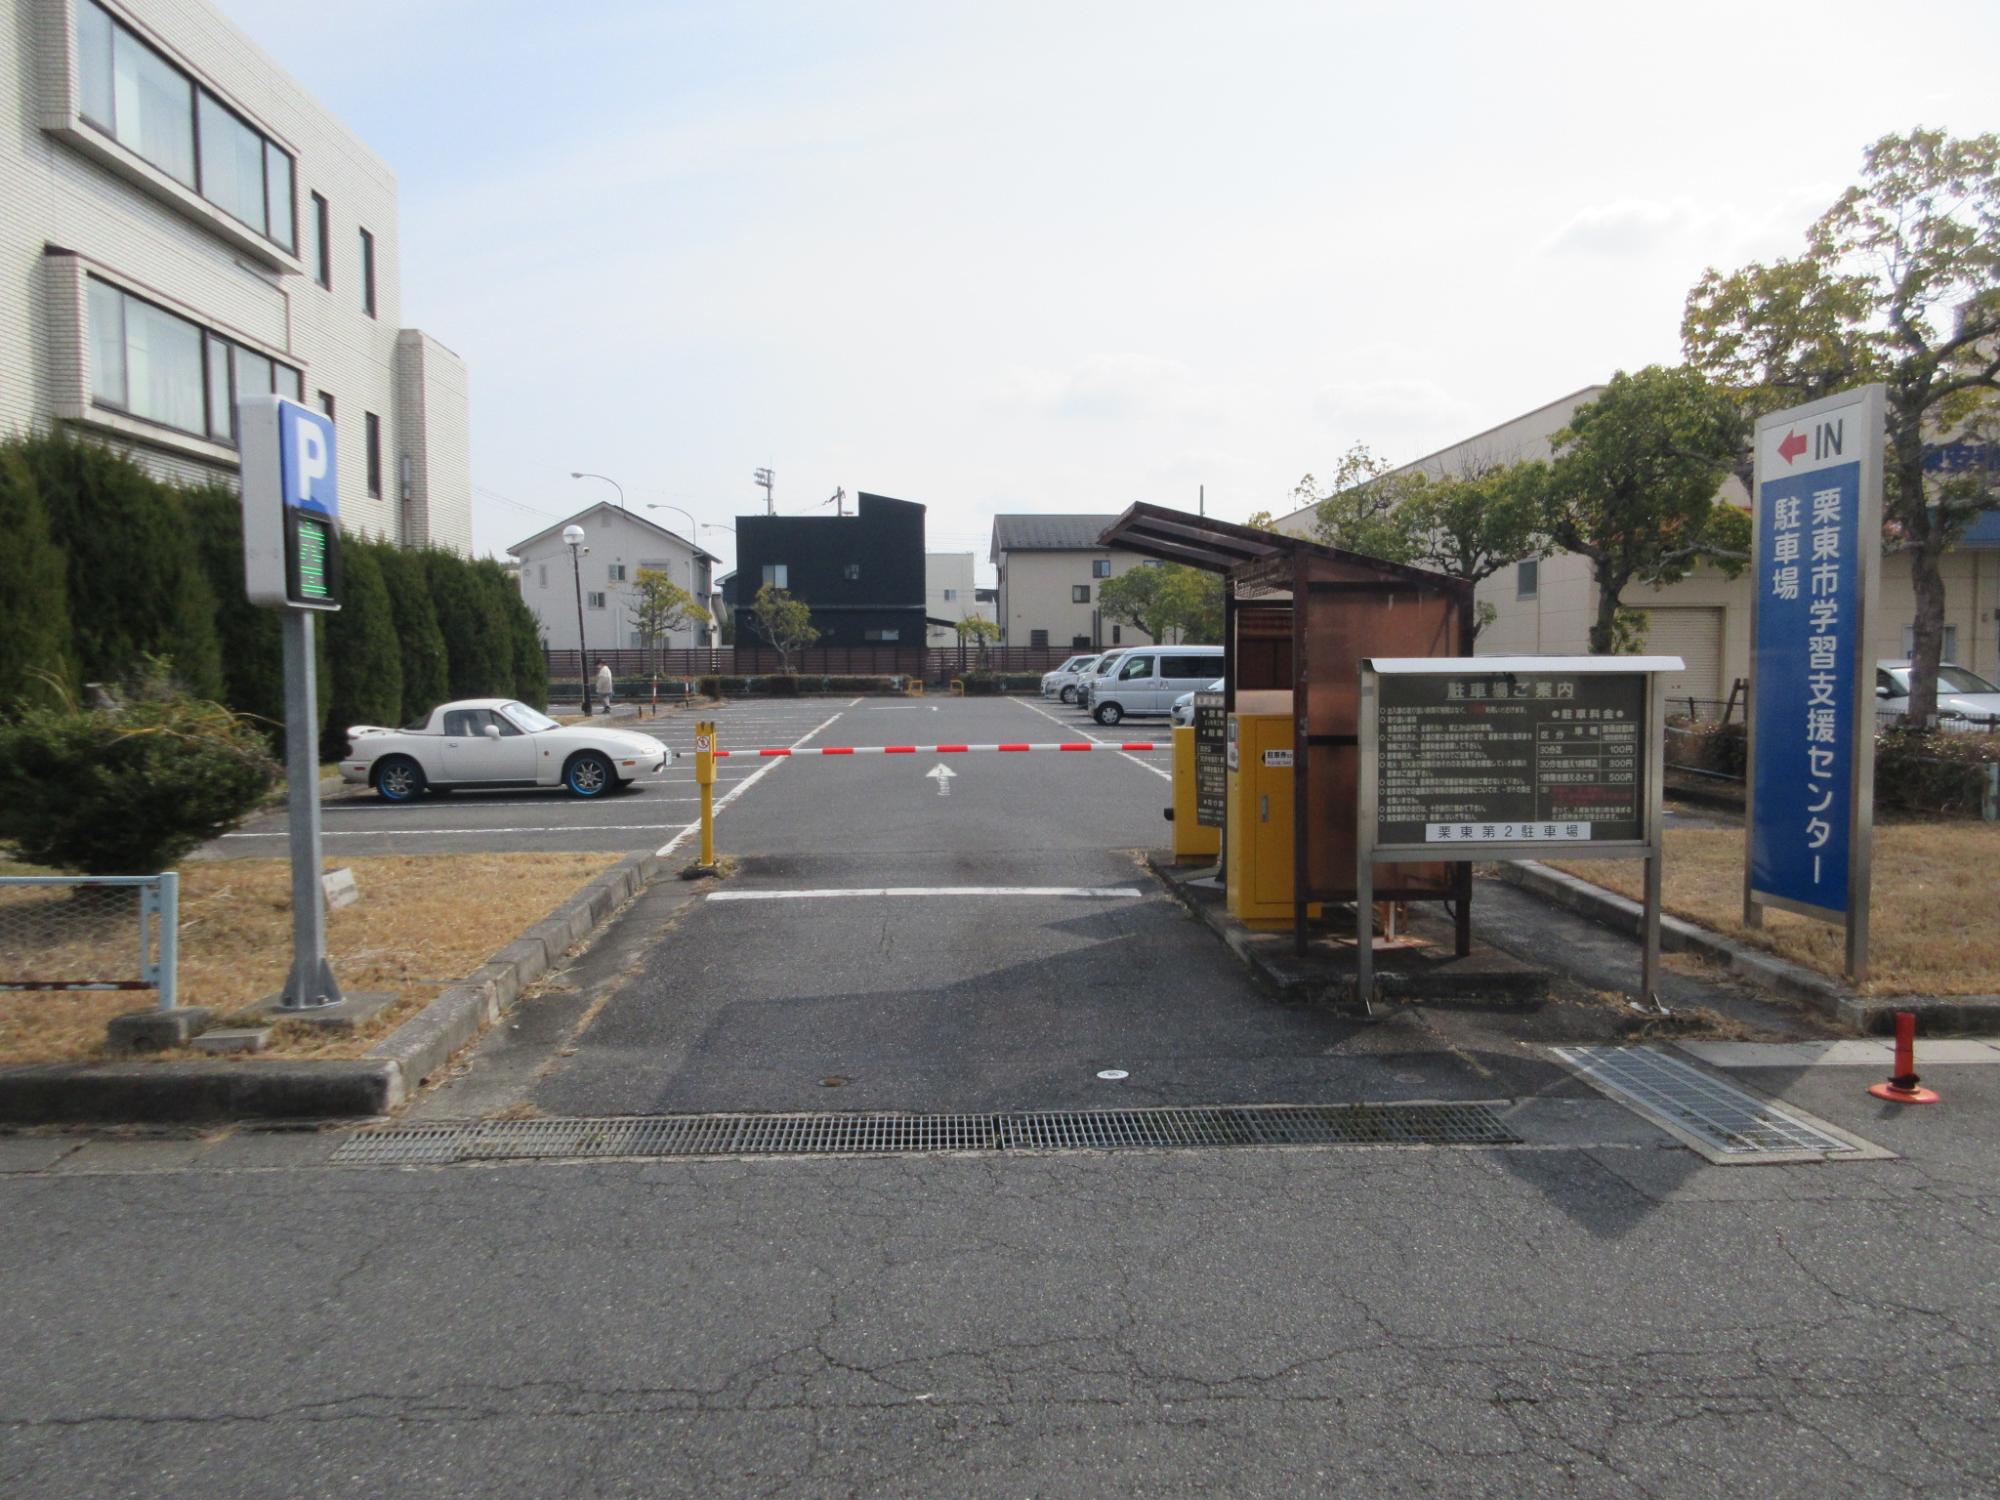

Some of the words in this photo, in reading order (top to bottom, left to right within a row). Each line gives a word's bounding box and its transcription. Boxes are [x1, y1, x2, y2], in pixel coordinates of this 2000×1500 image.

[296, 417, 328, 501] P
[1814, 418, 1843, 462] IN
[1771, 496, 1801, 601] 駐車場
[1446, 681, 1575, 699] 駐車場ご案内
[1805, 486, 1843, 885] 栗東市学習支援センター
[1609, 745, 1633, 754] 100円
[1437, 825, 1579, 839] 栗東第2駐車場
